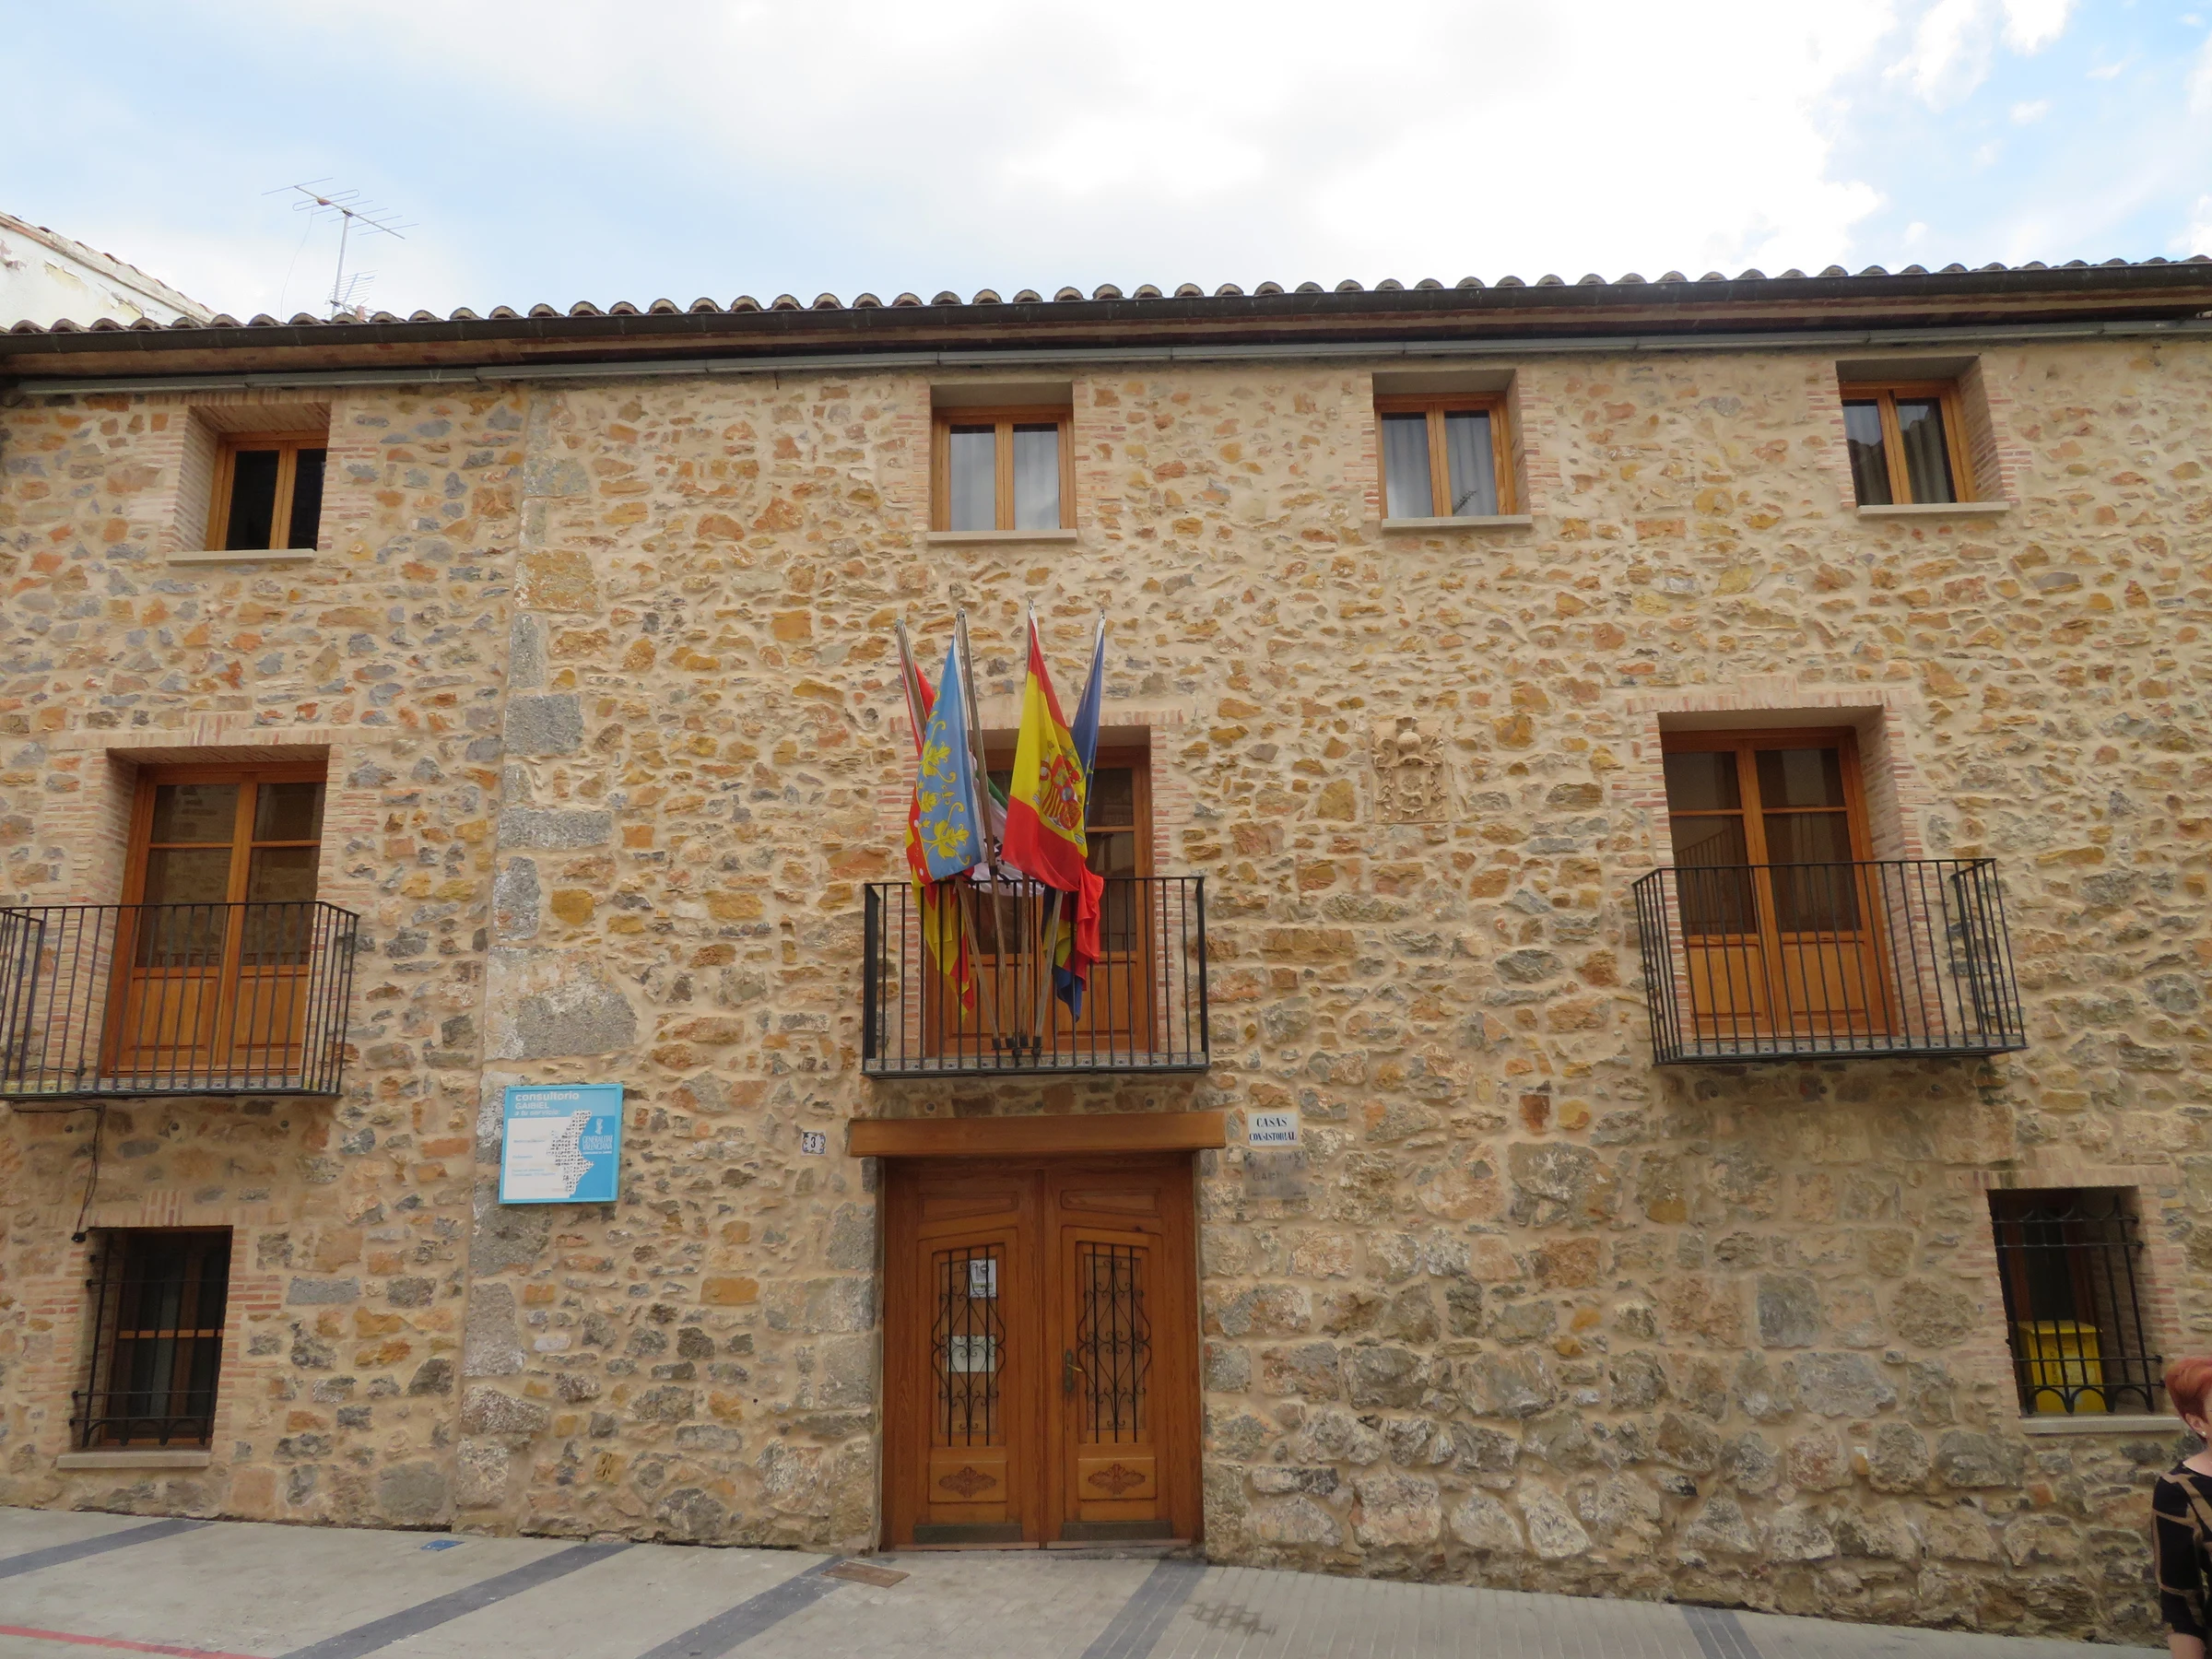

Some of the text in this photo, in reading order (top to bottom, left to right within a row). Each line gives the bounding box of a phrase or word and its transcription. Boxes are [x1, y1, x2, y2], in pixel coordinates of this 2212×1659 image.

[515, 1091, 580, 1101] consultorio
[514, 1101, 550, 1110] GAIBIEL
[1256, 1117, 1288, 1127] CASAS
[1249, 1131, 1297, 1141] CONSISTORIAL
[811, 1136, 816, 1148] 3
